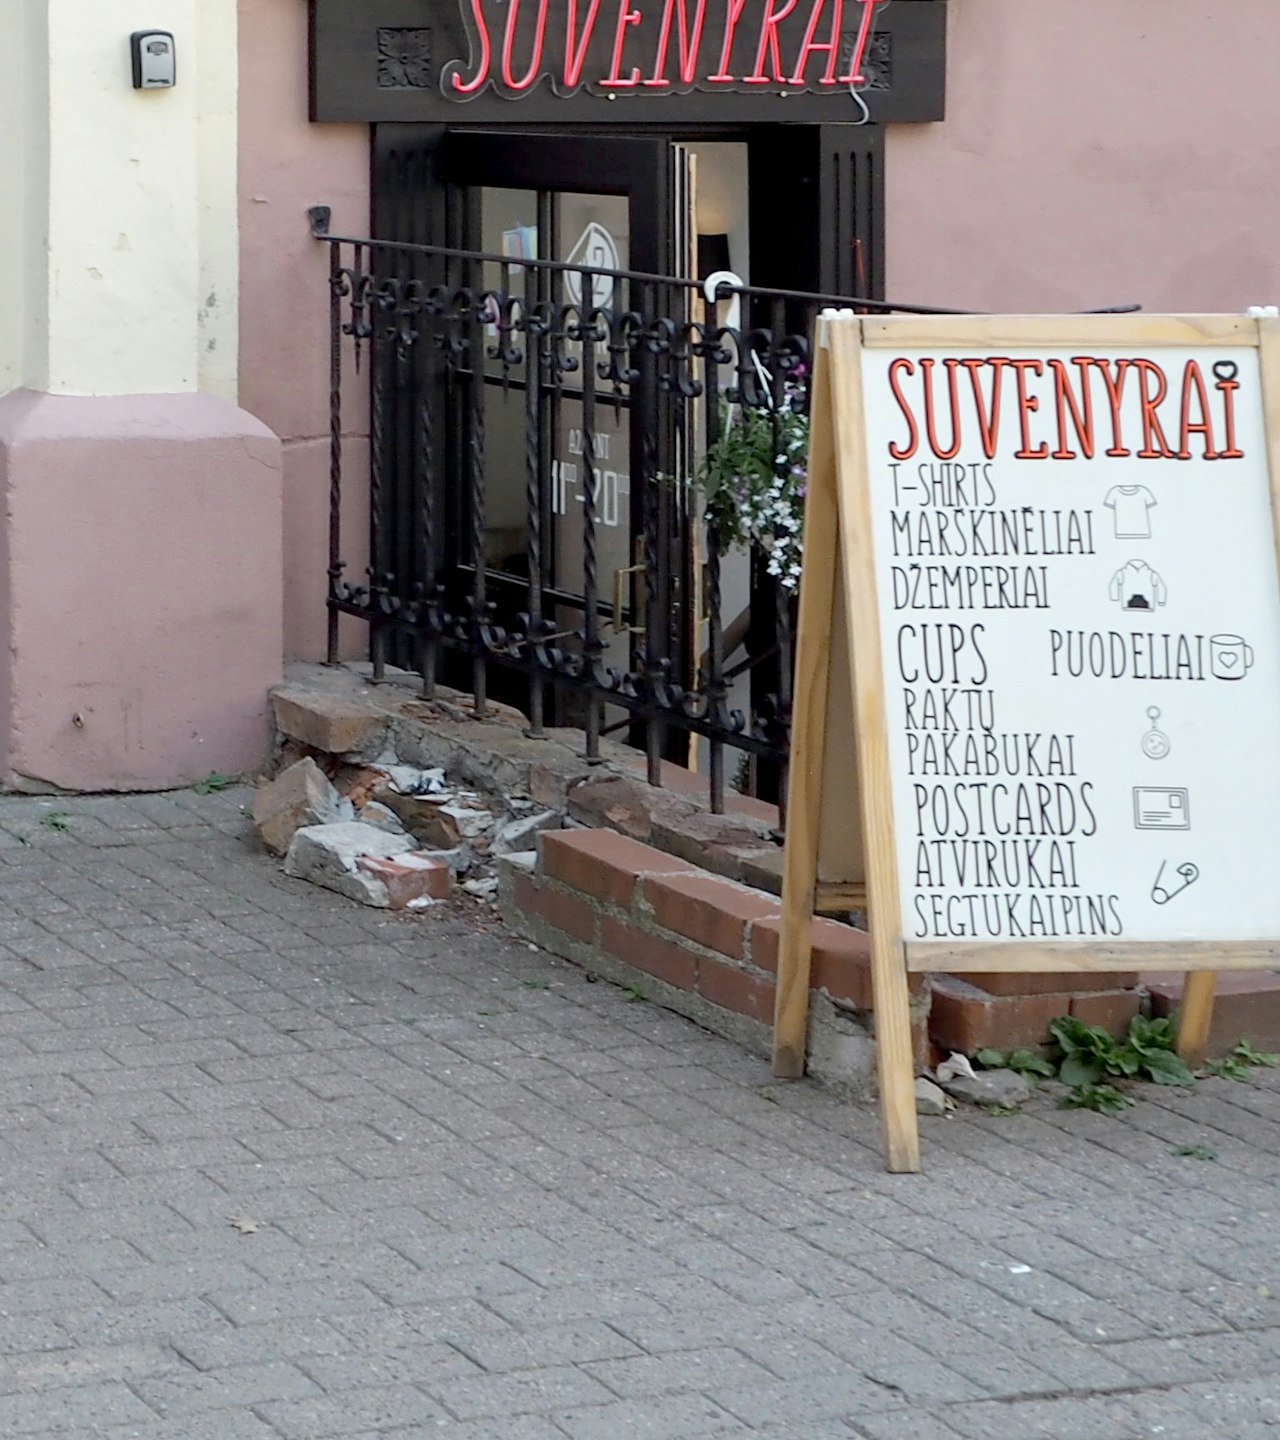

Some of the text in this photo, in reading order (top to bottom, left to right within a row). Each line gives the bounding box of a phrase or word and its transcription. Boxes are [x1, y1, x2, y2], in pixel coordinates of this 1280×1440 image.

[888, 356, 1245, 460] SUVENYRAI
[888, 462, 997, 508] T-SHIRTS
[890, 562, 1052, 610] DŽEMPERIAI
[898, 623, 1206, 686] CUPS PUODELIAI
[903, 687, 995, 733] RAKTŲ
[906, 732, 1078, 777] PAKABUKAI
[913, 781, 1098, 837] POSTCARDS
[914, 839, 1081, 889] ATVIRUKAI
